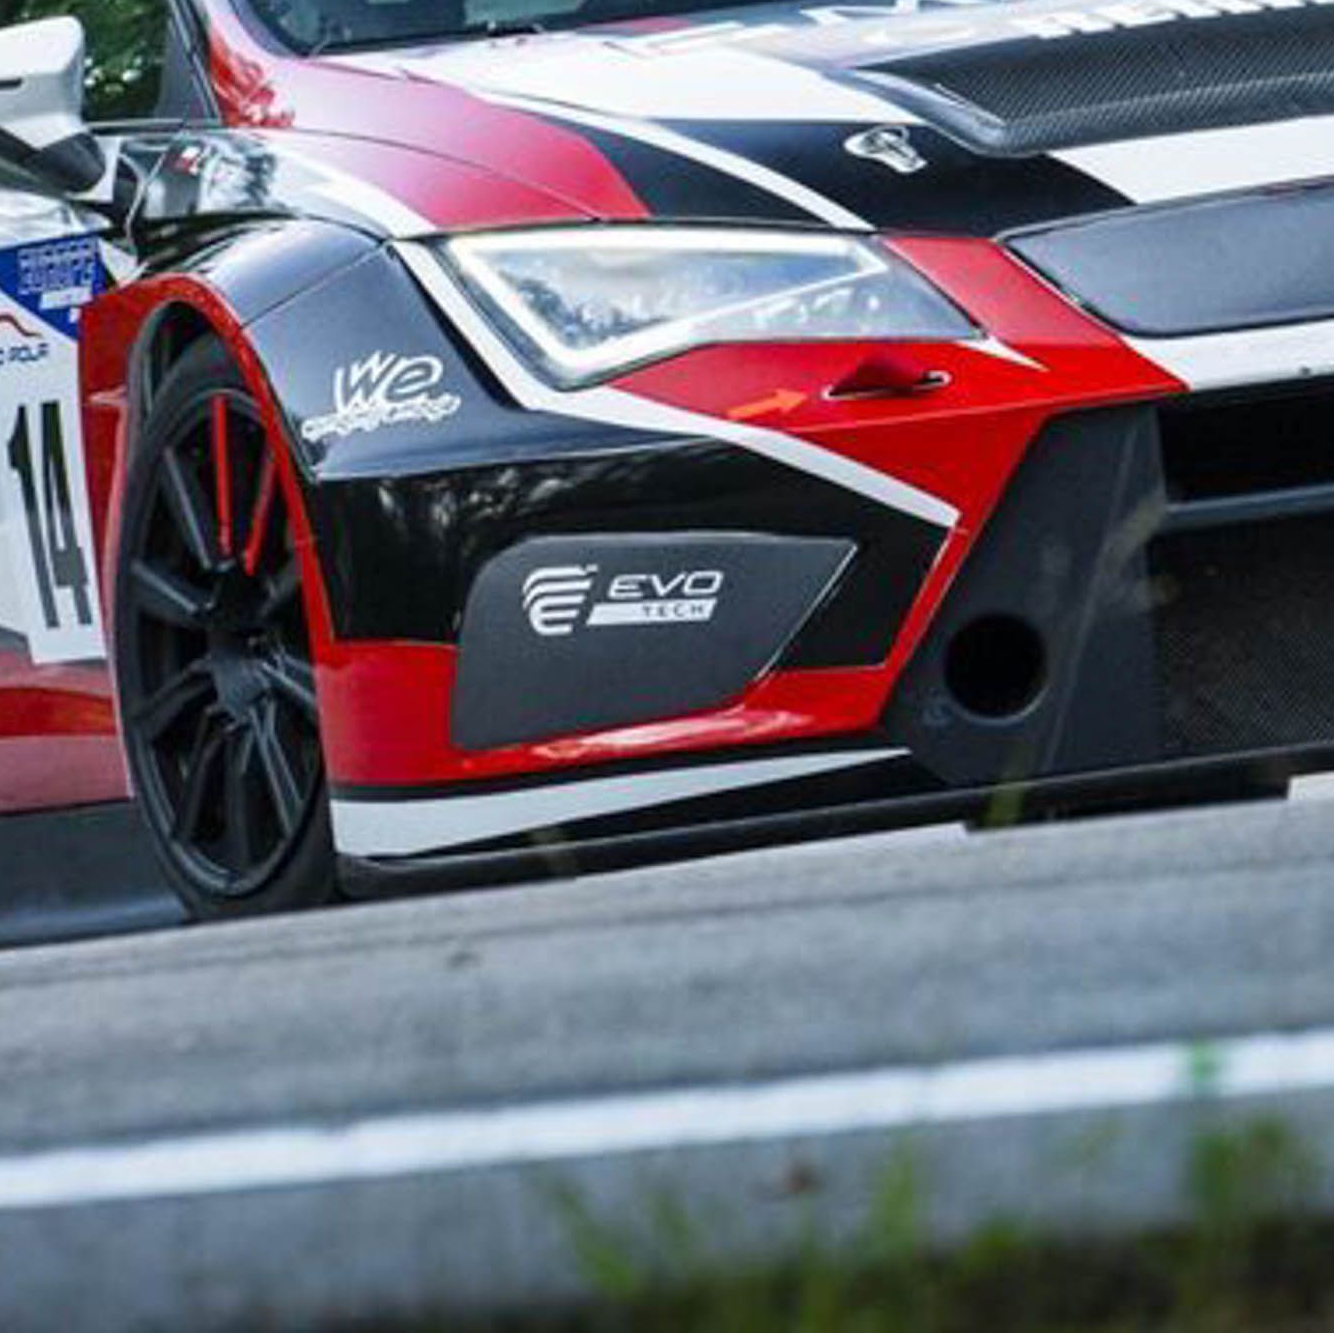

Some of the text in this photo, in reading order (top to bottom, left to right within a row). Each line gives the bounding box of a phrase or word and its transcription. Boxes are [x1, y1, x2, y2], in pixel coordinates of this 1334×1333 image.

[7, 399, 94, 629] 14
[607, 569, 724, 601] EVO
[641, 601, 705, 618] TECH
